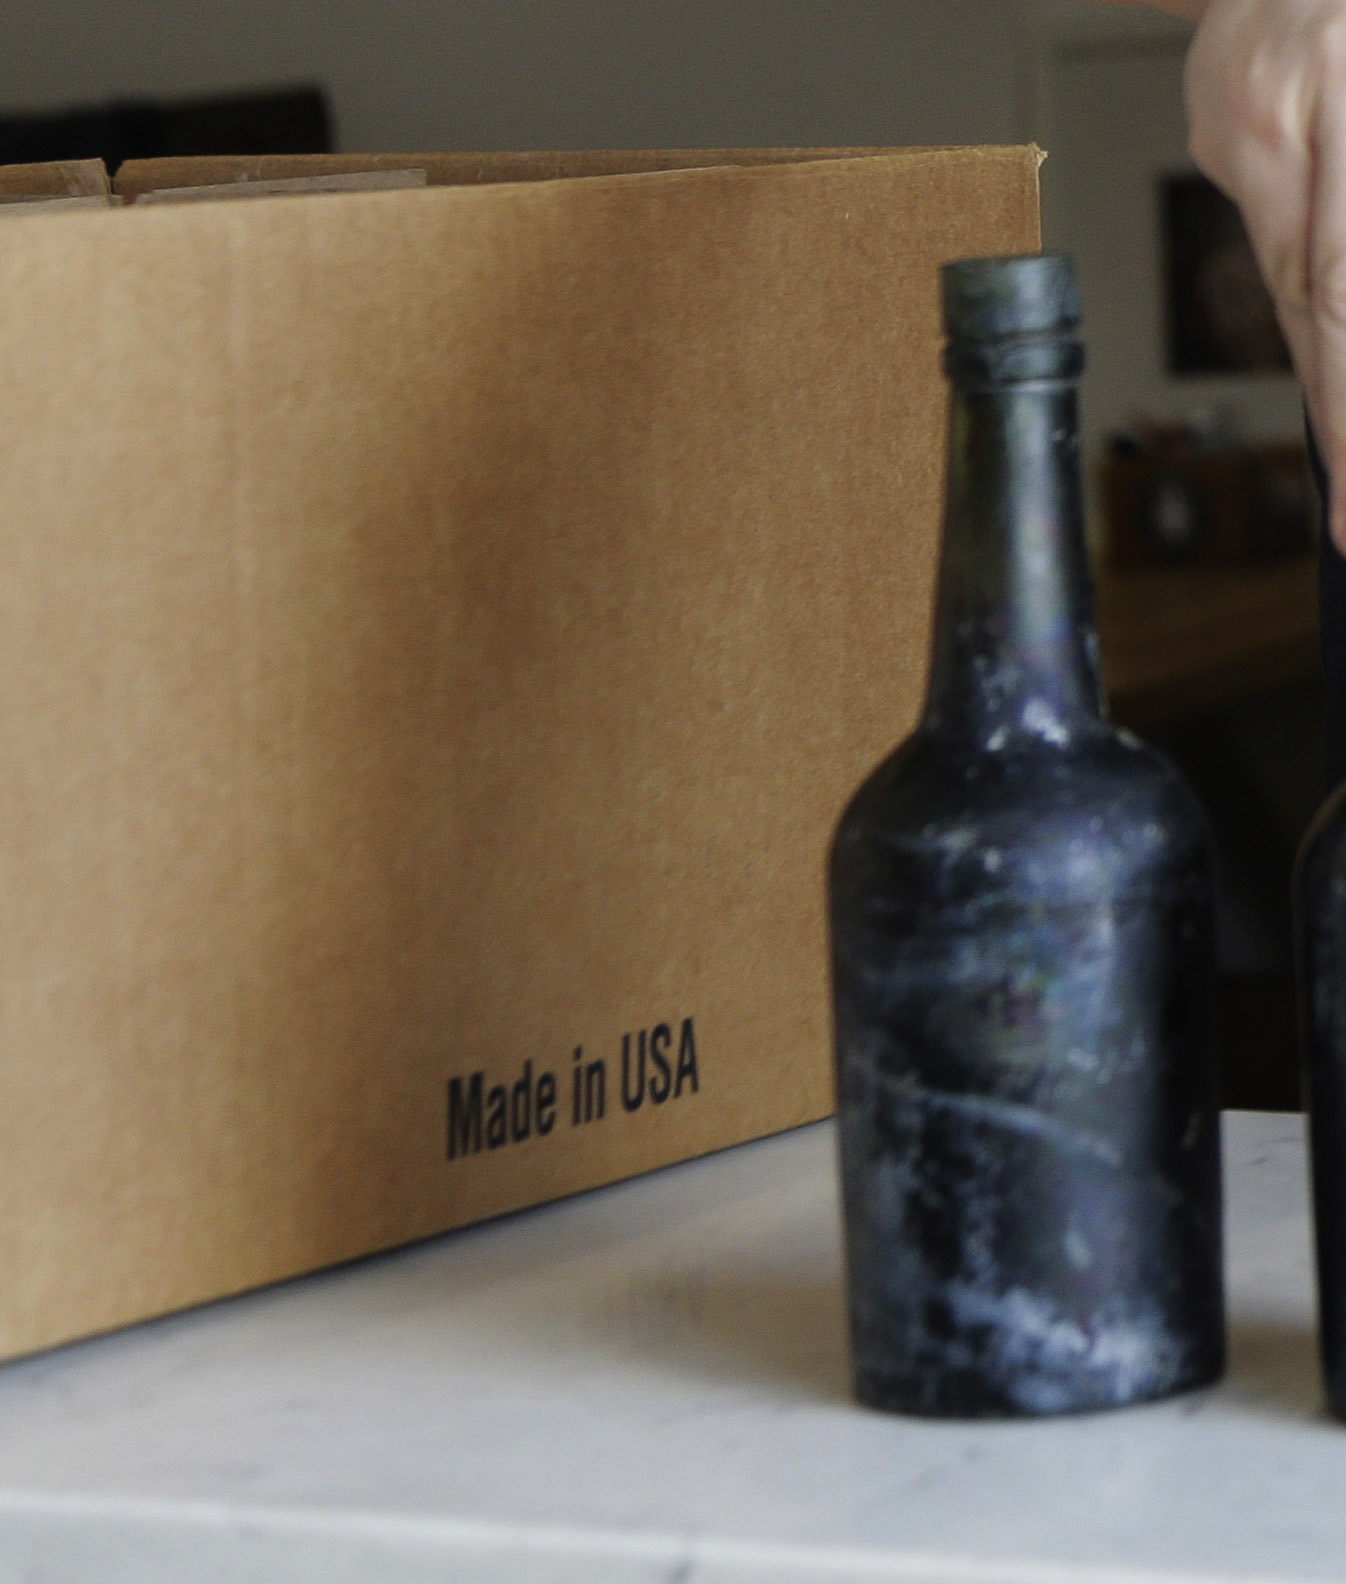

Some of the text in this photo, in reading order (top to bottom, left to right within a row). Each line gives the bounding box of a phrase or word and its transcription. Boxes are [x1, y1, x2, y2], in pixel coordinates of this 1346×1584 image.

[446, 1016, 700, 1161] Made in USA
